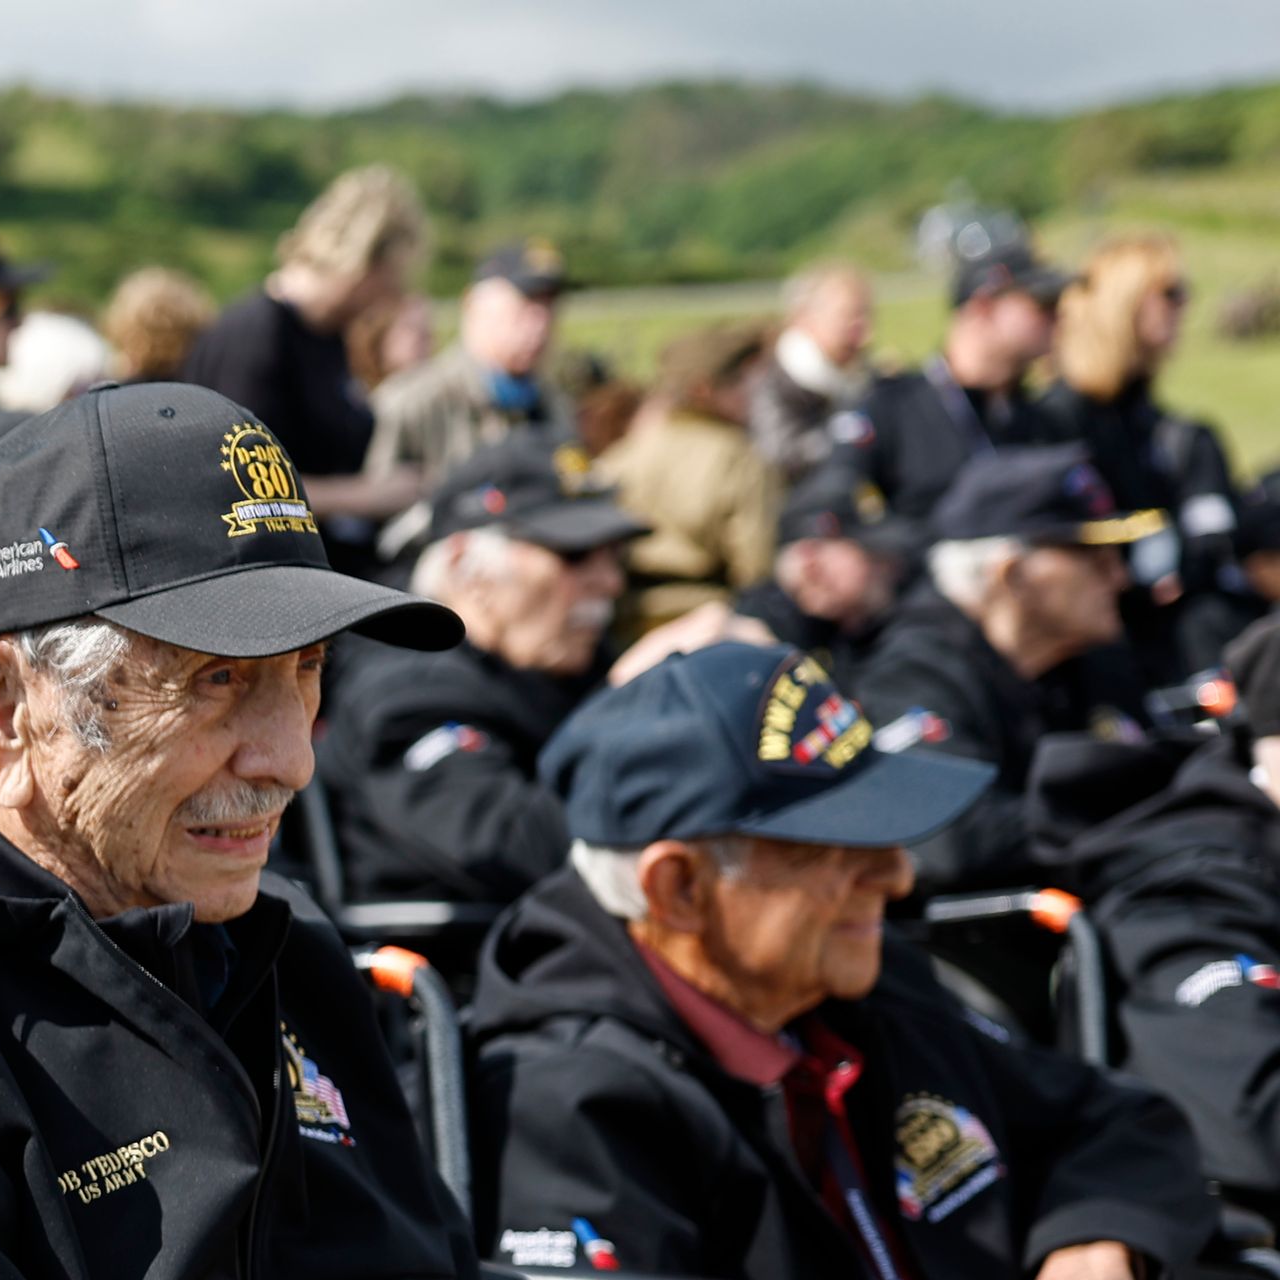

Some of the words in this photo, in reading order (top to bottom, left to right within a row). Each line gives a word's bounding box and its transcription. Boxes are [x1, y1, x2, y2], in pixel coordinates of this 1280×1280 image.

[247, 462, 290, 499] 80
[81, 1130, 170, 1181] TEDESCO
[78, 1182, 102, 1204] US
[104, 1162, 147, 1194] ARMY
